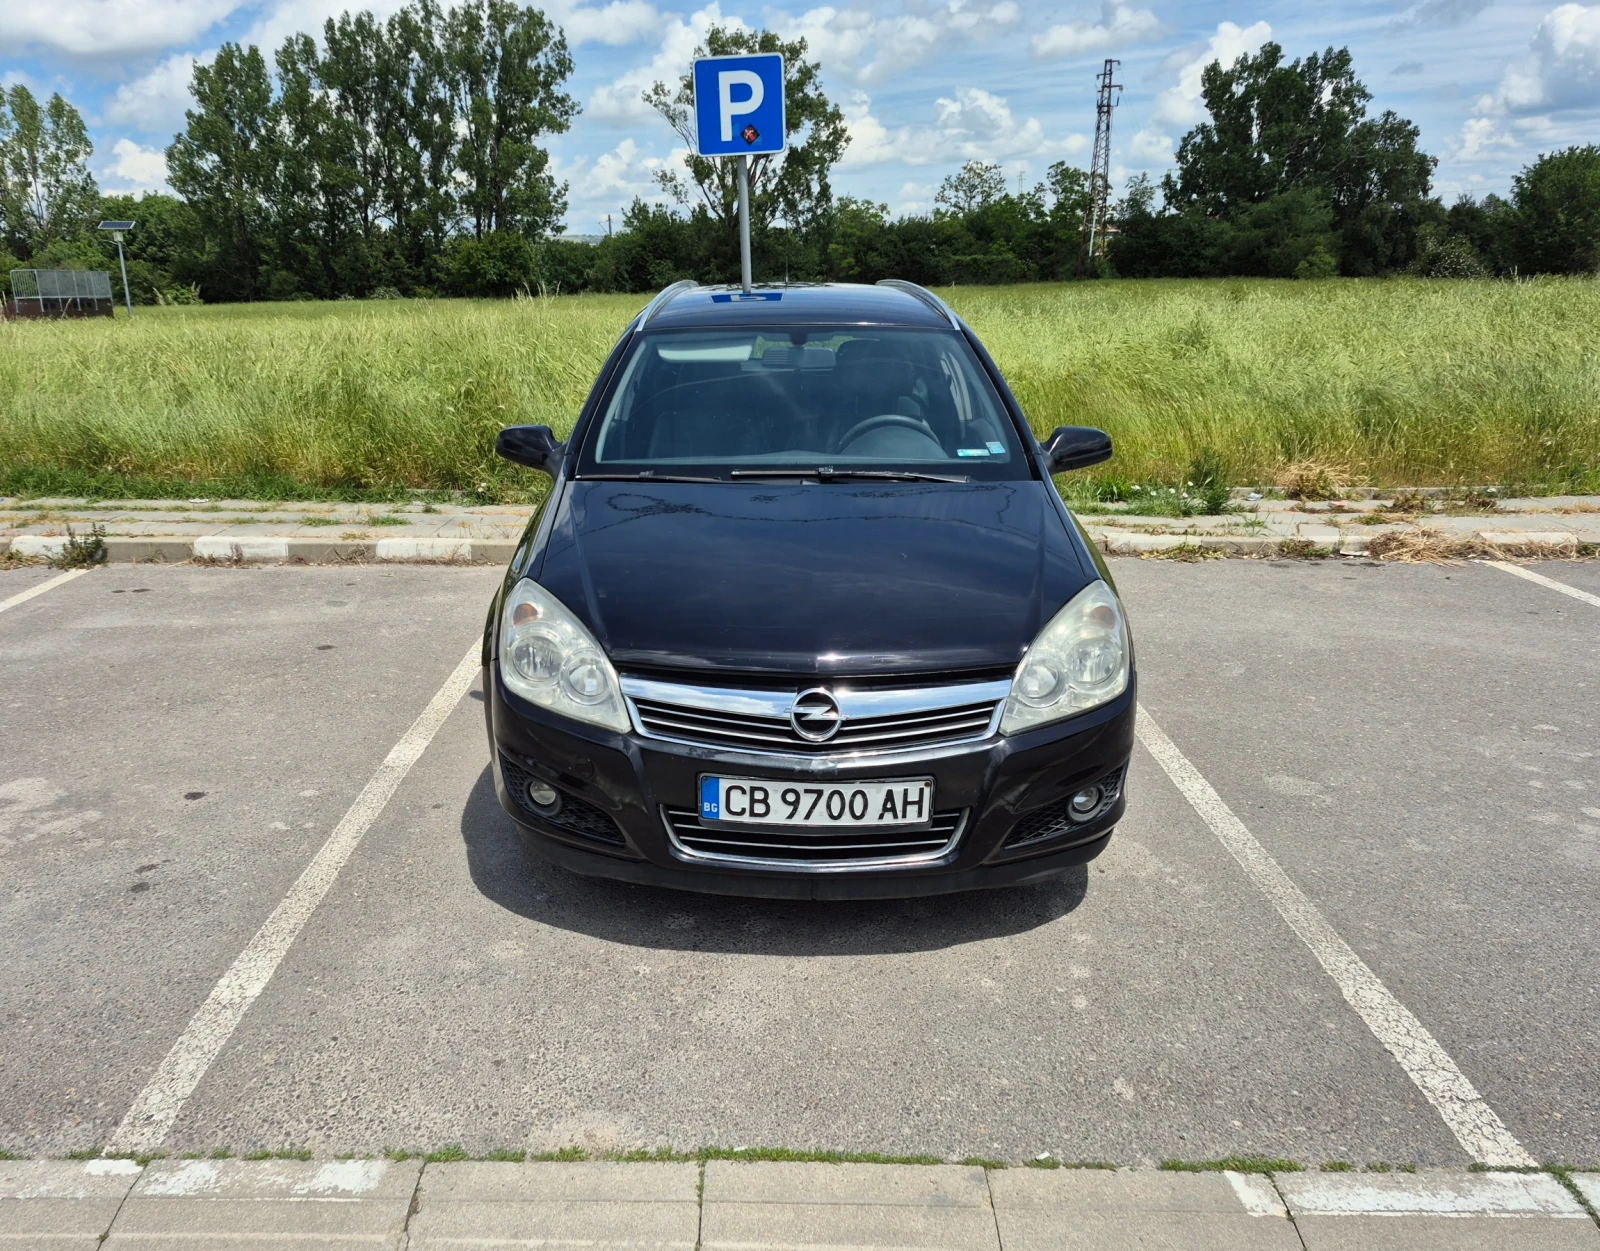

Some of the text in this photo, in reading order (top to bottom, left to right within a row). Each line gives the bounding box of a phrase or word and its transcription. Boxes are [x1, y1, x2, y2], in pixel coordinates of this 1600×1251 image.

[718, 70, 764, 142] P
[703, 802, 718, 813] BG
[725, 785, 925, 821] CB 9700 AH
